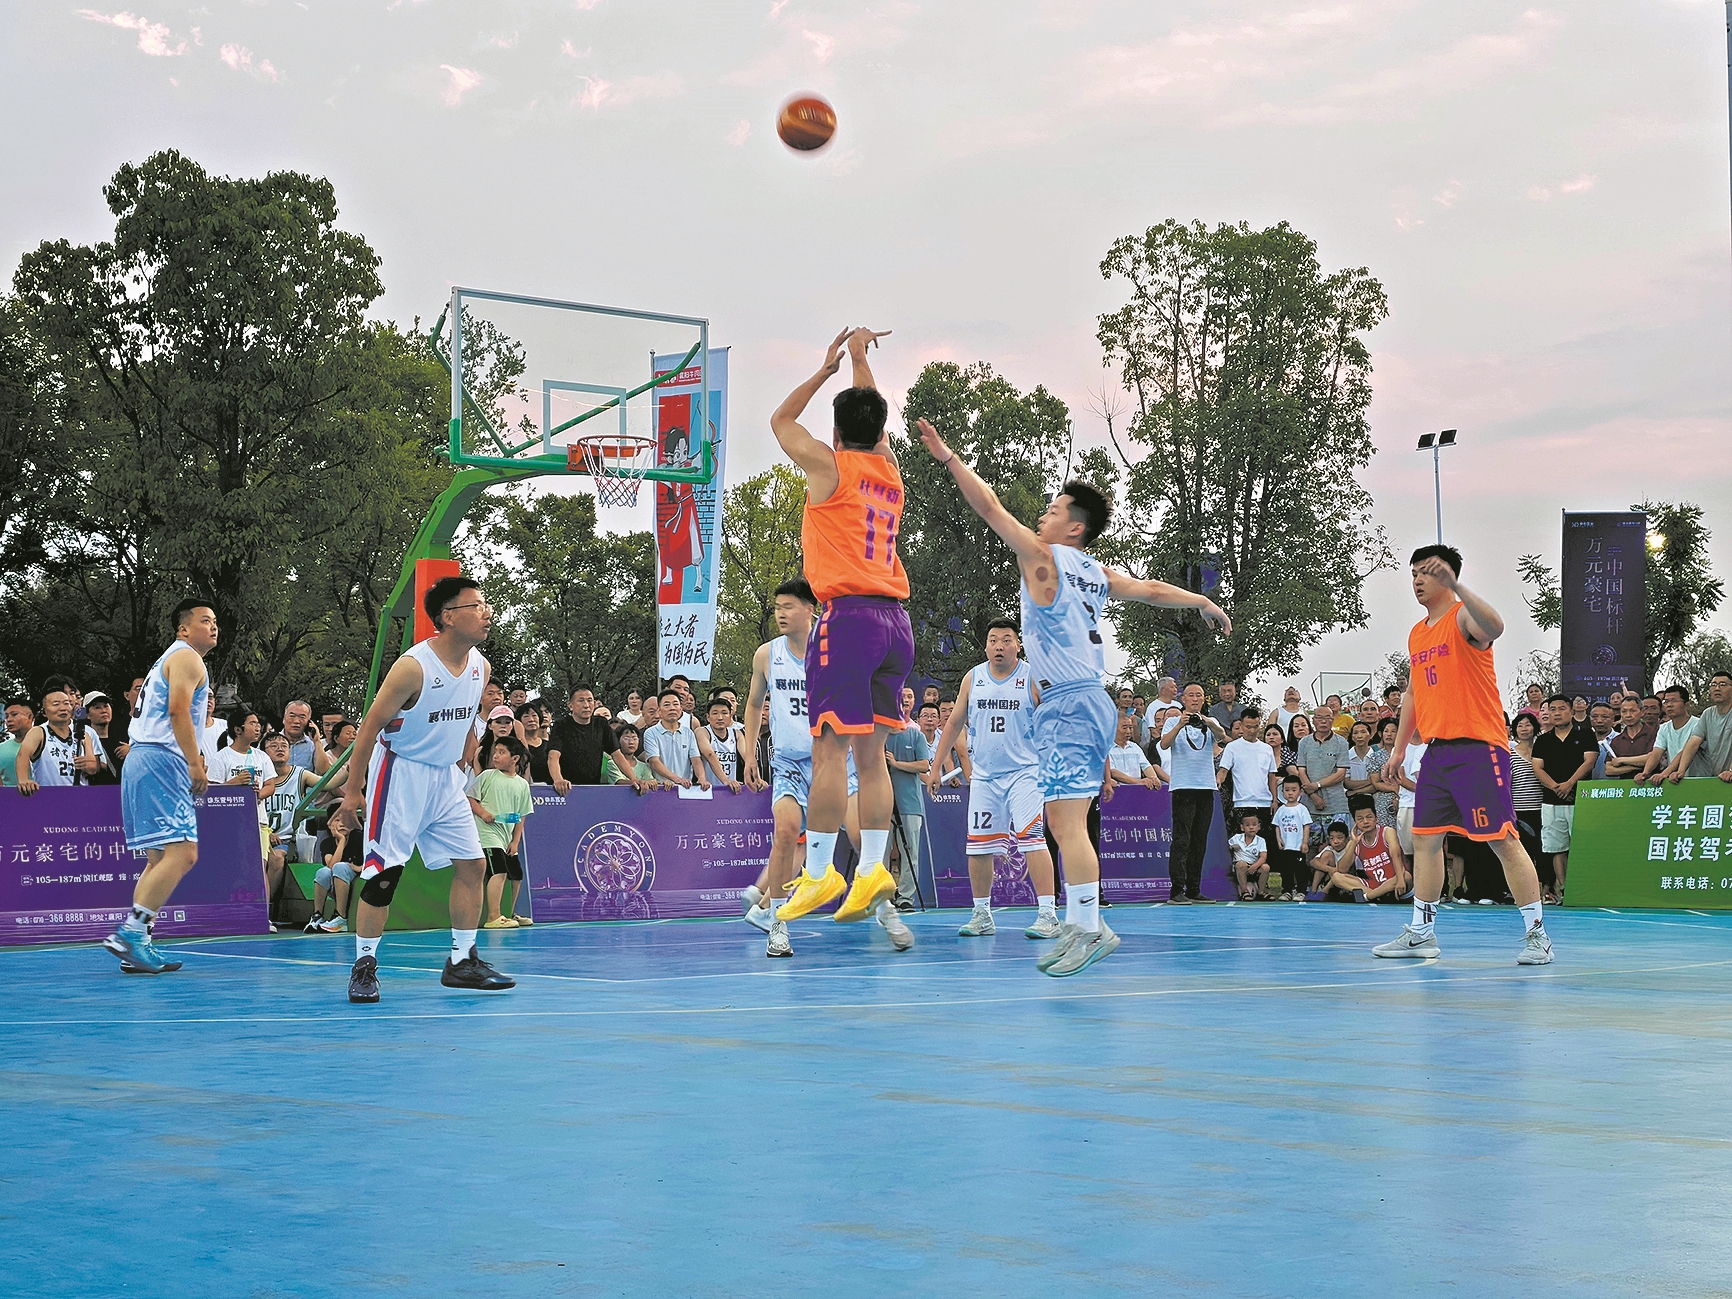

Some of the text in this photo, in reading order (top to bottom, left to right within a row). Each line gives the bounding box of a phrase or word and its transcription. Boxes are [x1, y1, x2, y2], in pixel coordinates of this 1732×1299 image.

[864, 503, 895, 566] 17
[1584, 536, 1603, 613] 万元豪宅
[664, 640, 711, 667] 为国为民
[1424, 665, 1438, 687] 16
[977, 699, 1021, 711] 襄州国投
[990, 716, 1006, 733] 12
[1590, 788, 1625, 798] 襄州国投
[265, 793, 296, 813] ELTICS
[973, 811, 993, 830] 12
[1471, 806, 1489, 829] 16
[43, 826, 79, 834] XUDONG
[1372, 868, 1388, 882] 12
